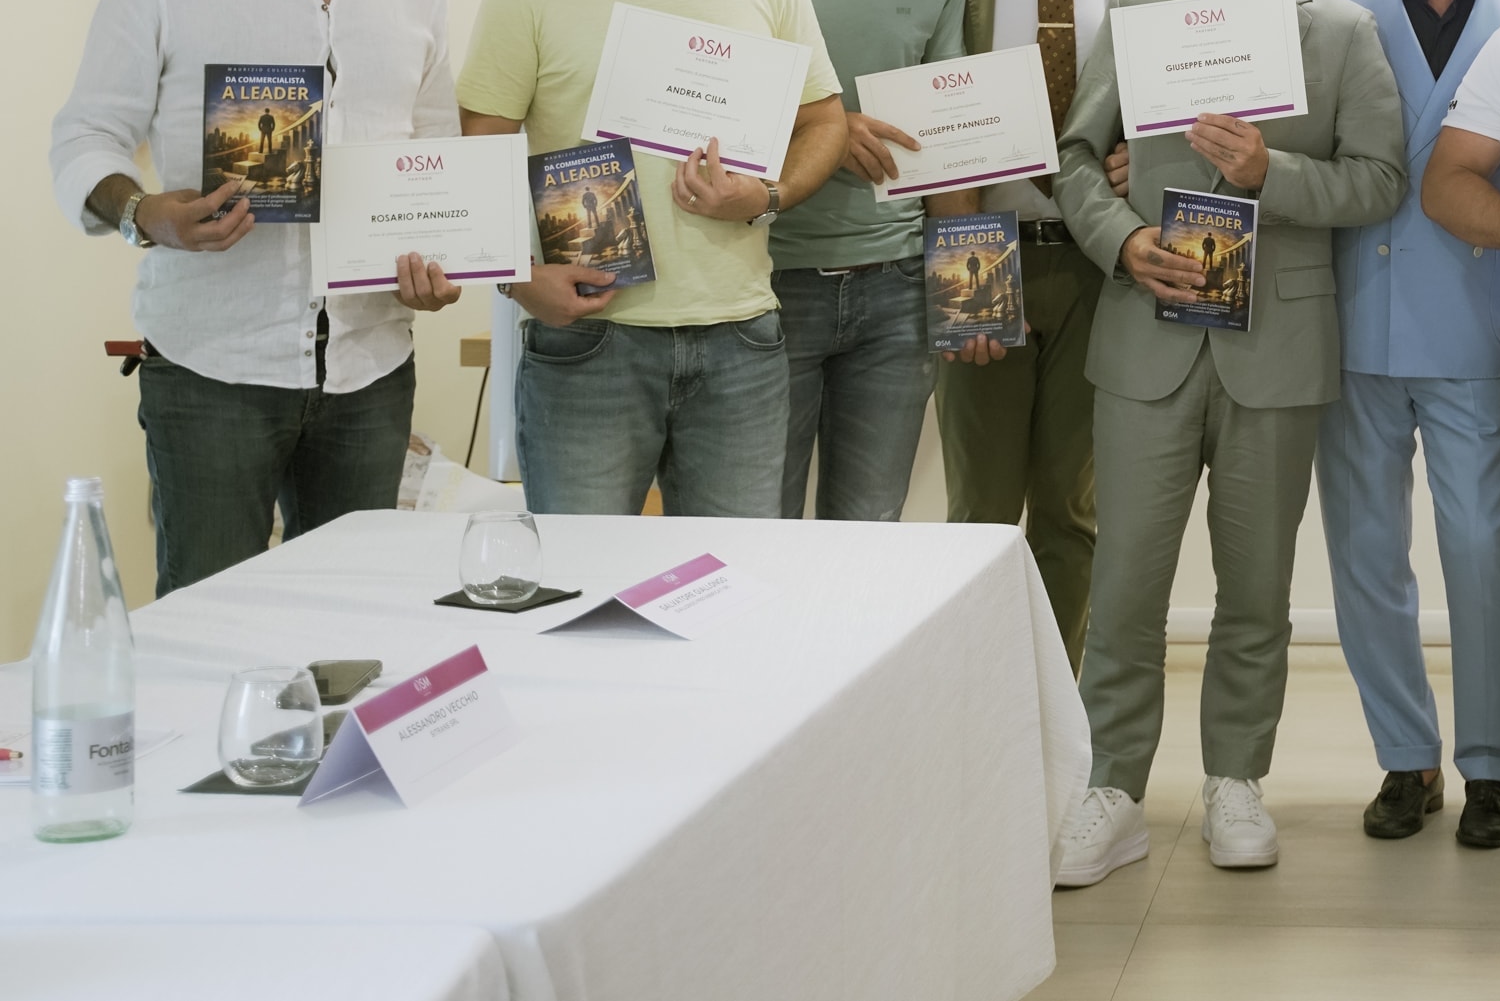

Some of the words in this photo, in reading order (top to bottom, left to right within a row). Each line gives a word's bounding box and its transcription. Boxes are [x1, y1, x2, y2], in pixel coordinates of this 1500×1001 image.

[1184, 8, 1226, 26] OSM
[688, 35, 731, 59] OSM
[1165, 60, 1203, 72] GIUSEPPE
[1204, 53, 1252, 67] MANGIONE
[238, 76, 305, 84] COMMERCIALISTA
[932, 71, 974, 90] OSM
[222, 85, 235, 100] A
[240, 86, 309, 101] LEADER
[665, 85, 702, 100] ANDREA
[705, 93, 728, 105] CILIA
[1190, 93, 1235, 107] Leadership
[662, 124, 711, 143] Leadership
[918, 124, 955, 138] GIUSEPPE
[957, 116, 1001, 130] PANNUZZO
[395, 154, 444, 173] OSM
[544, 164, 555, 172] DA
[555, 152, 615, 170] COMMERCIALISTA
[943, 155, 988, 170] Leadership
[545, 173, 557, 187] A
[560, 160, 622, 184] LEADER
[371, 212, 414, 223] ROSARIO
[417, 209, 469, 220] PANNUZZO
[1187, 203, 1240, 217] COMMERCIALISTA
[947, 222, 1002, 233] COMMERCIALISTA
[1175, 210, 1185, 221] A
[1189, 211, 1243, 231] LEADER
[936, 236, 947, 248] A
[950, 231, 1006, 247] LEADER
[398, 707, 447, 741] ALESSANDRO
[446, 690, 479, 714] VECCHIO
[89, 736, 134, 760] Fonta
